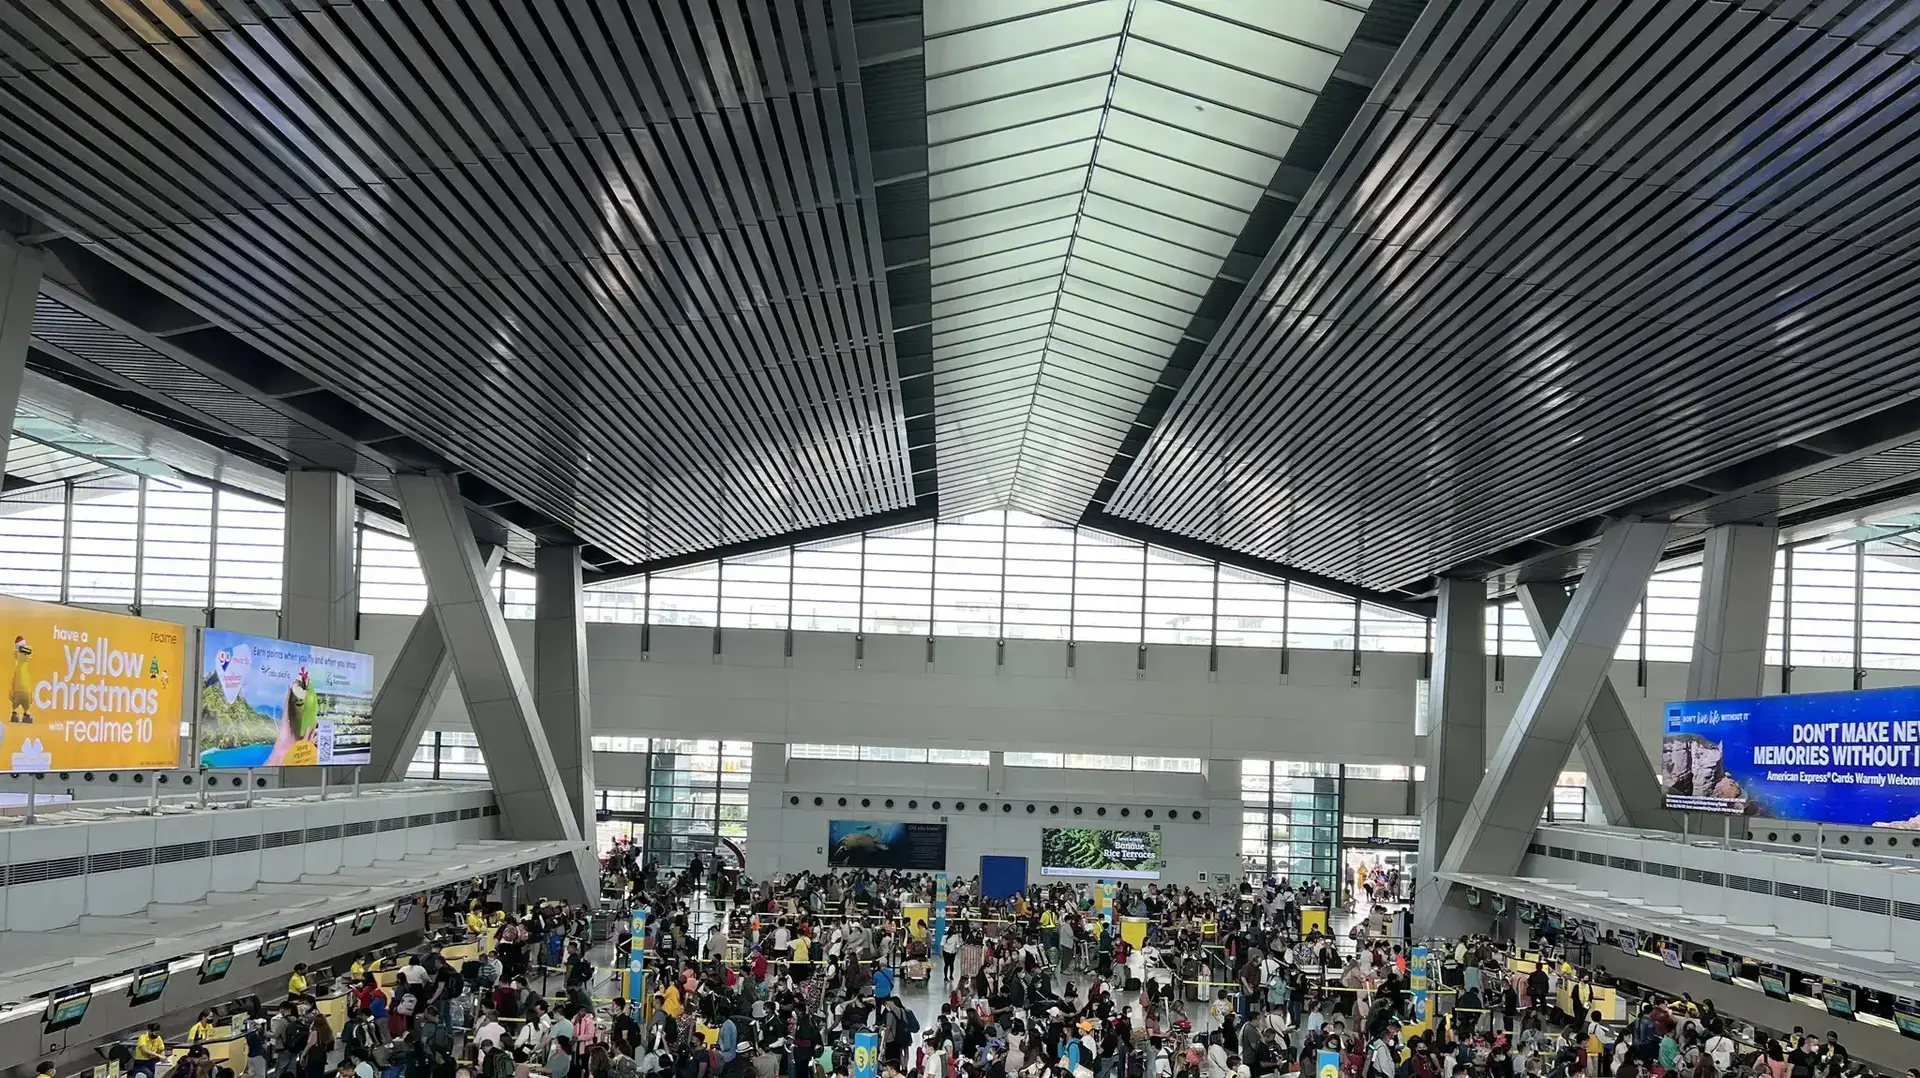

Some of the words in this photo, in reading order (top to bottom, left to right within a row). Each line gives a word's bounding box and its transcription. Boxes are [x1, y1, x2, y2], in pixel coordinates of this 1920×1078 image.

[53, 624, 79, 642] have
[80, 631, 88, 643] a
[150, 631, 177, 645] realme
[64, 637, 144, 682] yellow
[267, 648, 284, 660] points
[284, 650, 297, 660] when
[34, 671, 158, 715] christmas
[1682, 715, 1697, 723] DON'T
[1720, 713, 1743, 721] WITHOUT
[49, 721, 64, 731] with
[65, 716, 133, 742] realme
[135, 718, 153, 743] 10
[1793, 723, 1840, 743] DON'T
[1841, 721, 1889, 743] MAKE
[1893, 720, 1920, 742] NE
[1754, 745, 1829, 766] MEMORIES
[1832, 745, 1911, 767] WITHOUT
[1767, 770, 1799, 782] American
[1831, 772, 1854, 784] Cards
[1855, 772, 1886, 787] Warmly
[1103, 849, 1121, 858] Rice
[1120, 850, 1156, 859] Terraces
[858, 1056, 865, 1068] 3
